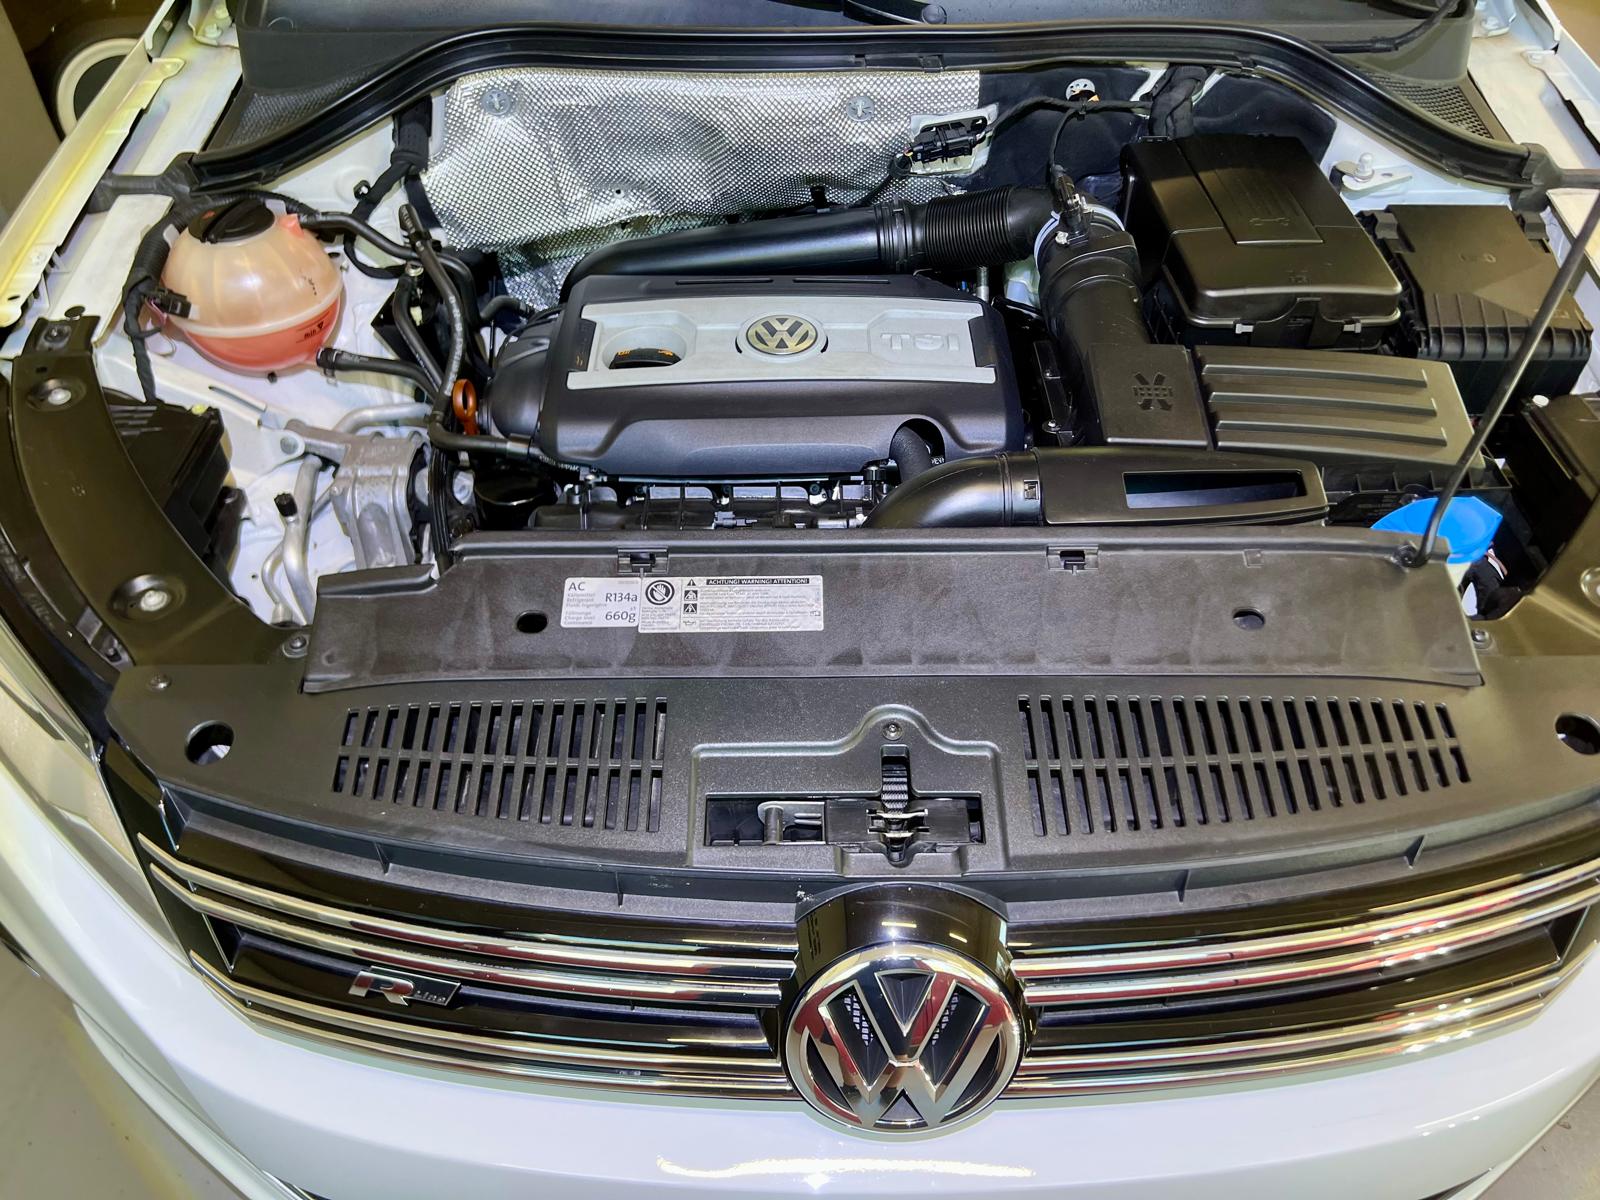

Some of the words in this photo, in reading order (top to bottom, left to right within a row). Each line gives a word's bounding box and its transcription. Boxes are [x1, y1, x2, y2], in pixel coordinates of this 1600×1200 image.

[304, 328, 317, 340] min
[879, 332, 961, 351] TSI
[568, 581, 586, 591] AC
[605, 592, 638, 602] R134a
[605, 610, 636, 623] 660g
